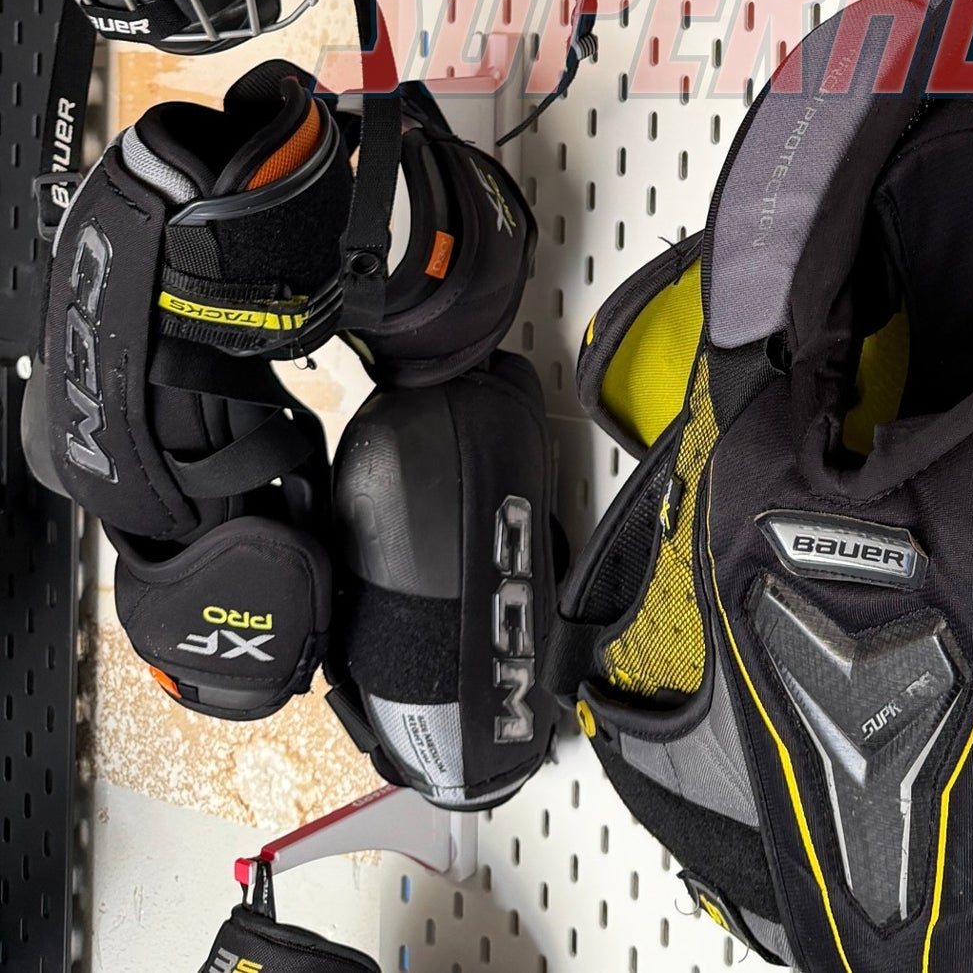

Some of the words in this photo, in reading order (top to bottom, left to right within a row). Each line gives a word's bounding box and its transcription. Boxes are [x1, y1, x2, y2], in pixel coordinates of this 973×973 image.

[169, 298, 258, 324] TACKS
[65, 217, 119, 484] CCM
[202, 605, 273, 631] PRO
[492, 494, 535, 743] CCM
[176, 629, 275, 662] XF
